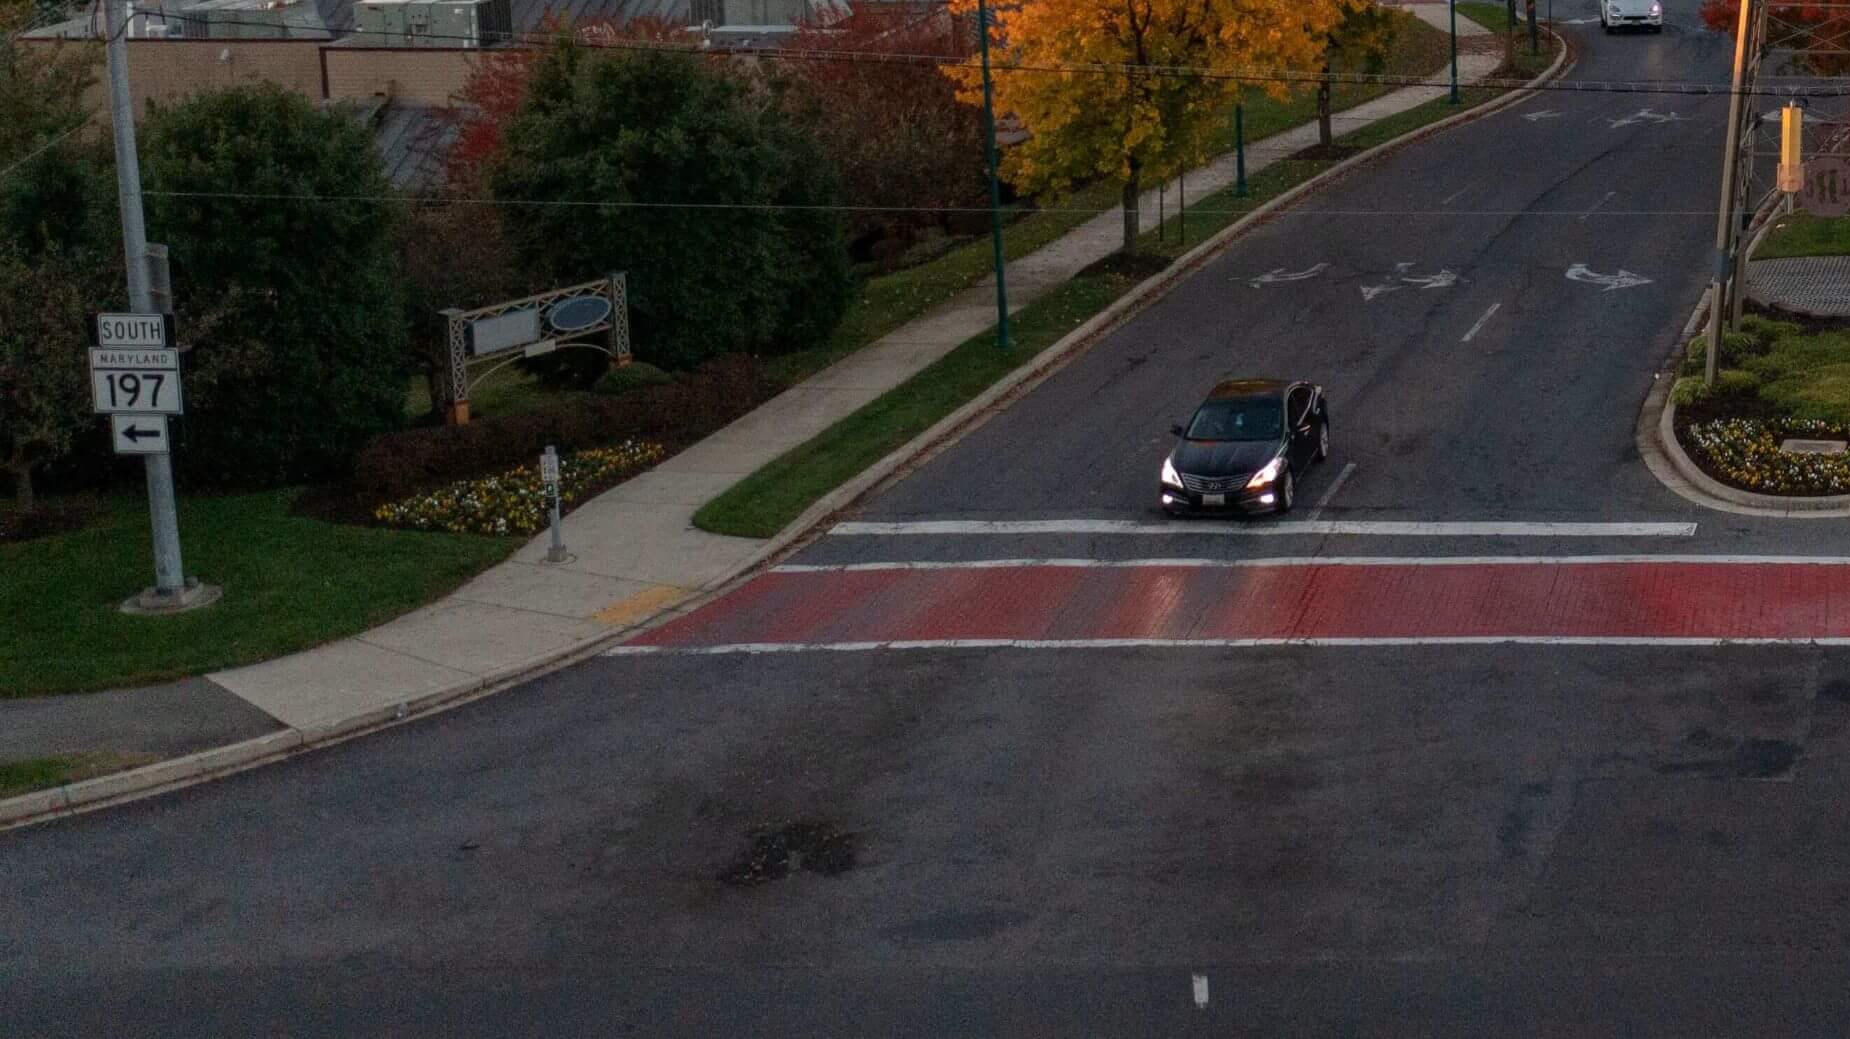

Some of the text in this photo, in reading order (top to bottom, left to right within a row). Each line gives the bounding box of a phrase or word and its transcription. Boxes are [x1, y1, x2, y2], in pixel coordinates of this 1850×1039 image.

[102, 321, 161, 340] SOUTH
[100, 353, 168, 364] MARYLAND
[106, 373, 165, 408] 197
